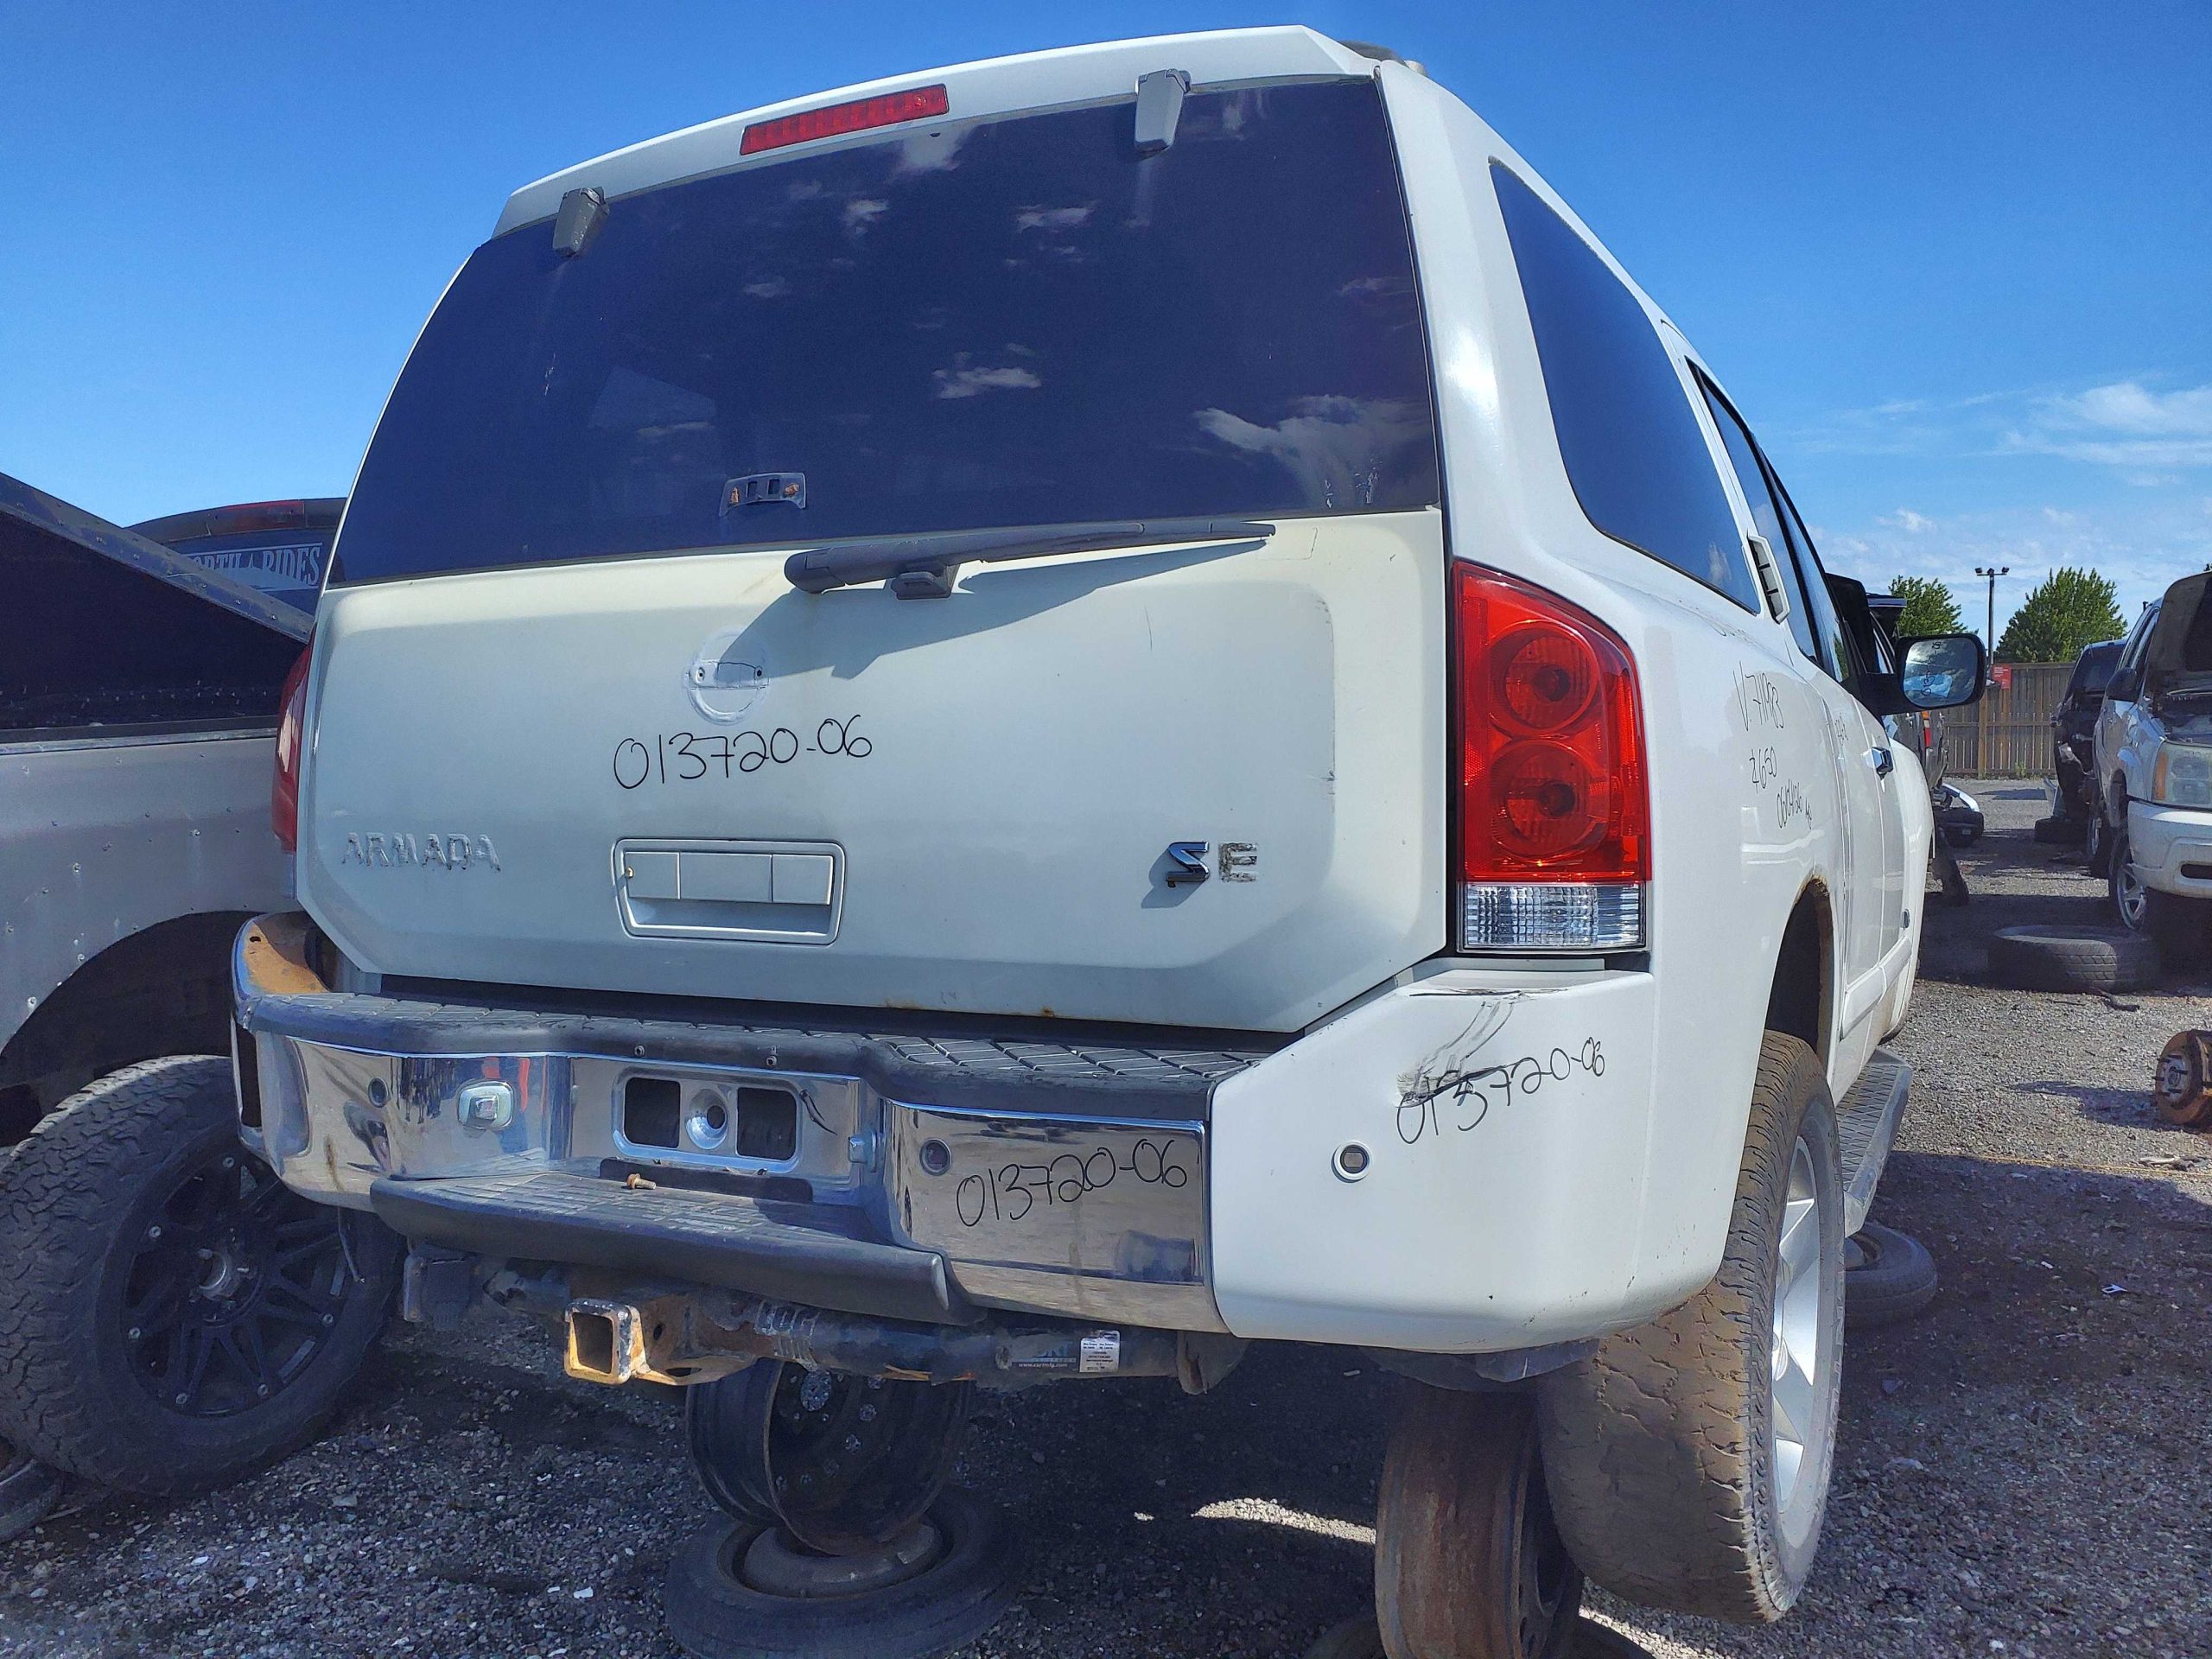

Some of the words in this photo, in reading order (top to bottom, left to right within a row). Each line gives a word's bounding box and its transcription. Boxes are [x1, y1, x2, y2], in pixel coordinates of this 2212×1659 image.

[263, 547, 321, 585] RIDES
[613, 715, 873, 789] 013720-06
[341, 832, 500, 871] ARMADA
[1166, 841, 1258, 885] SE
[957, 1139, 1188, 1227] 013720-06
